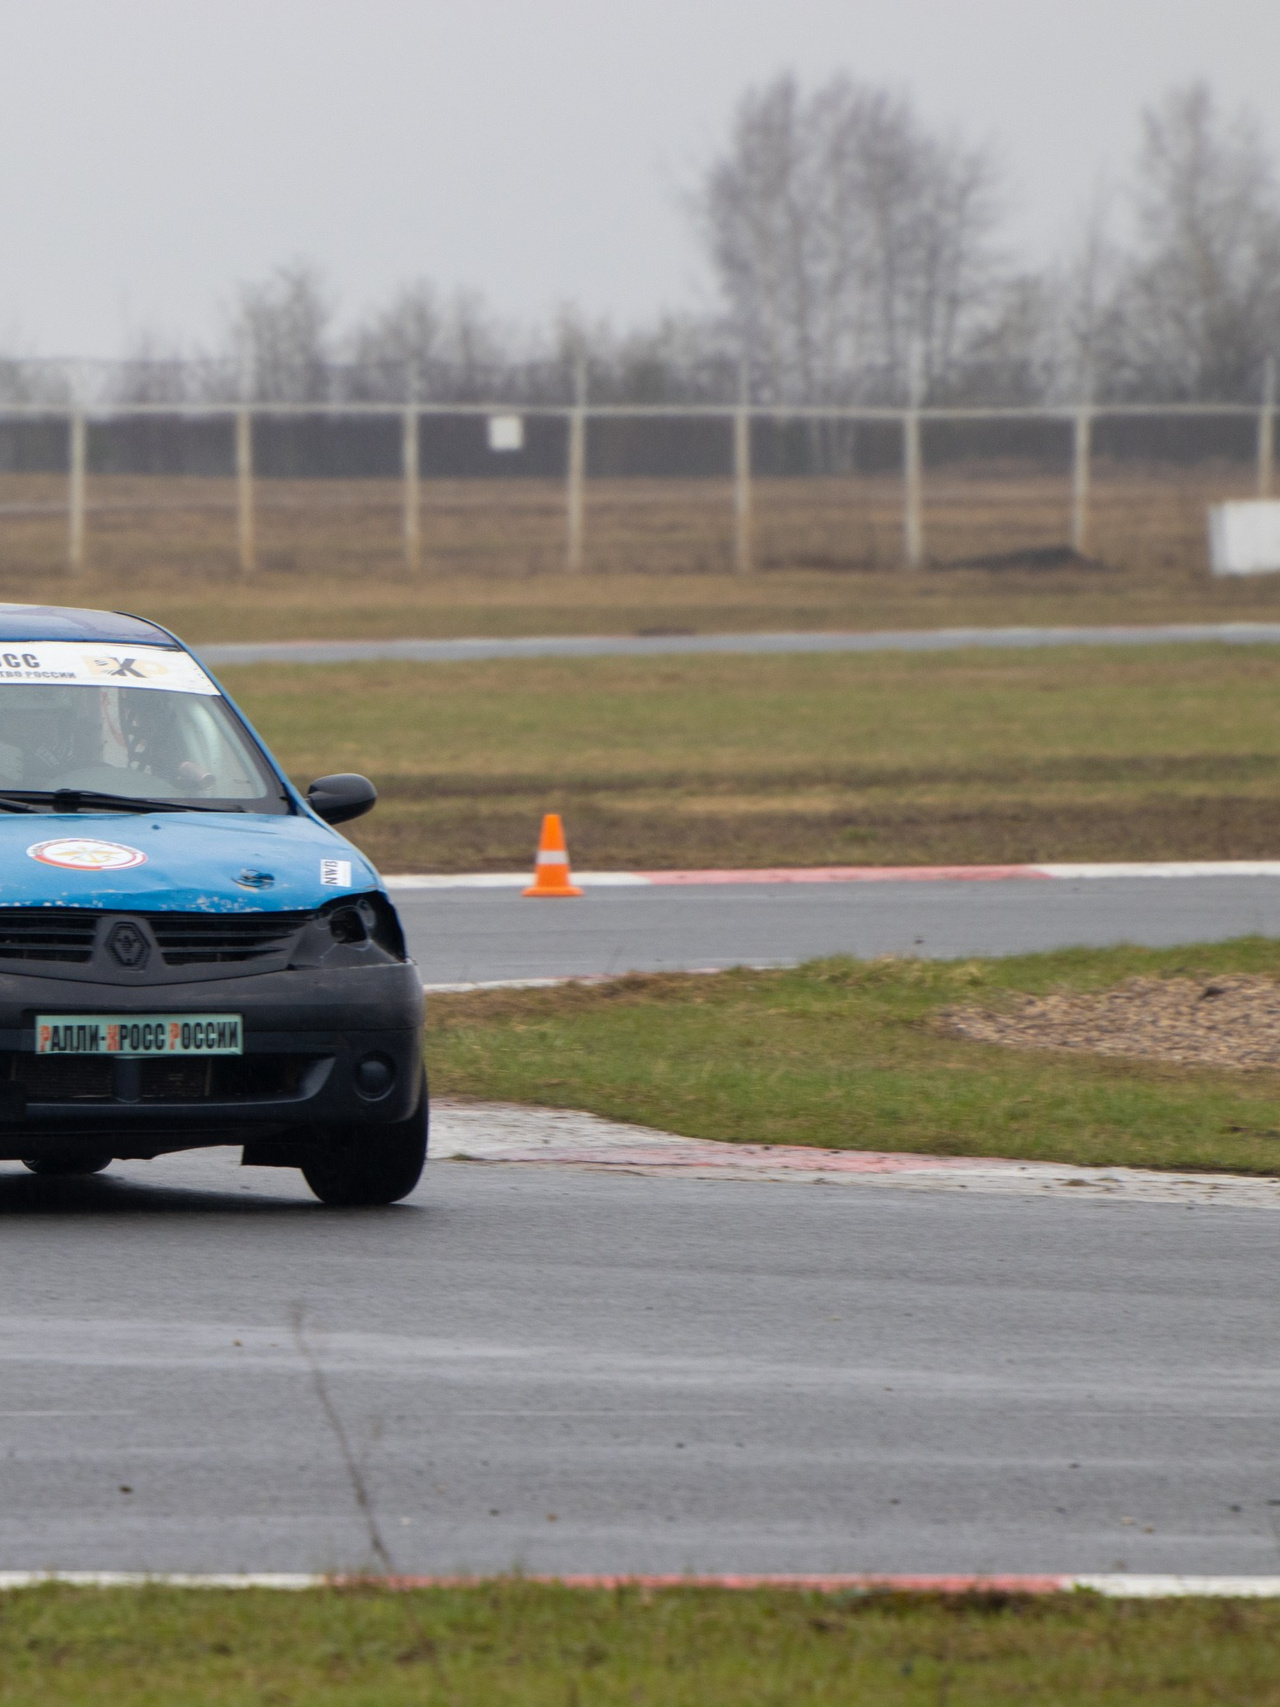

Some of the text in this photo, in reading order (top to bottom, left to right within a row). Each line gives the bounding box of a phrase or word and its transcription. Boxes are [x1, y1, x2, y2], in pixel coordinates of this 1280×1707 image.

[25, 671, 77, 680] РОССИИ
[39, 1021, 238, 1052] РАЛЛИ-КРОСС РОССИИ
